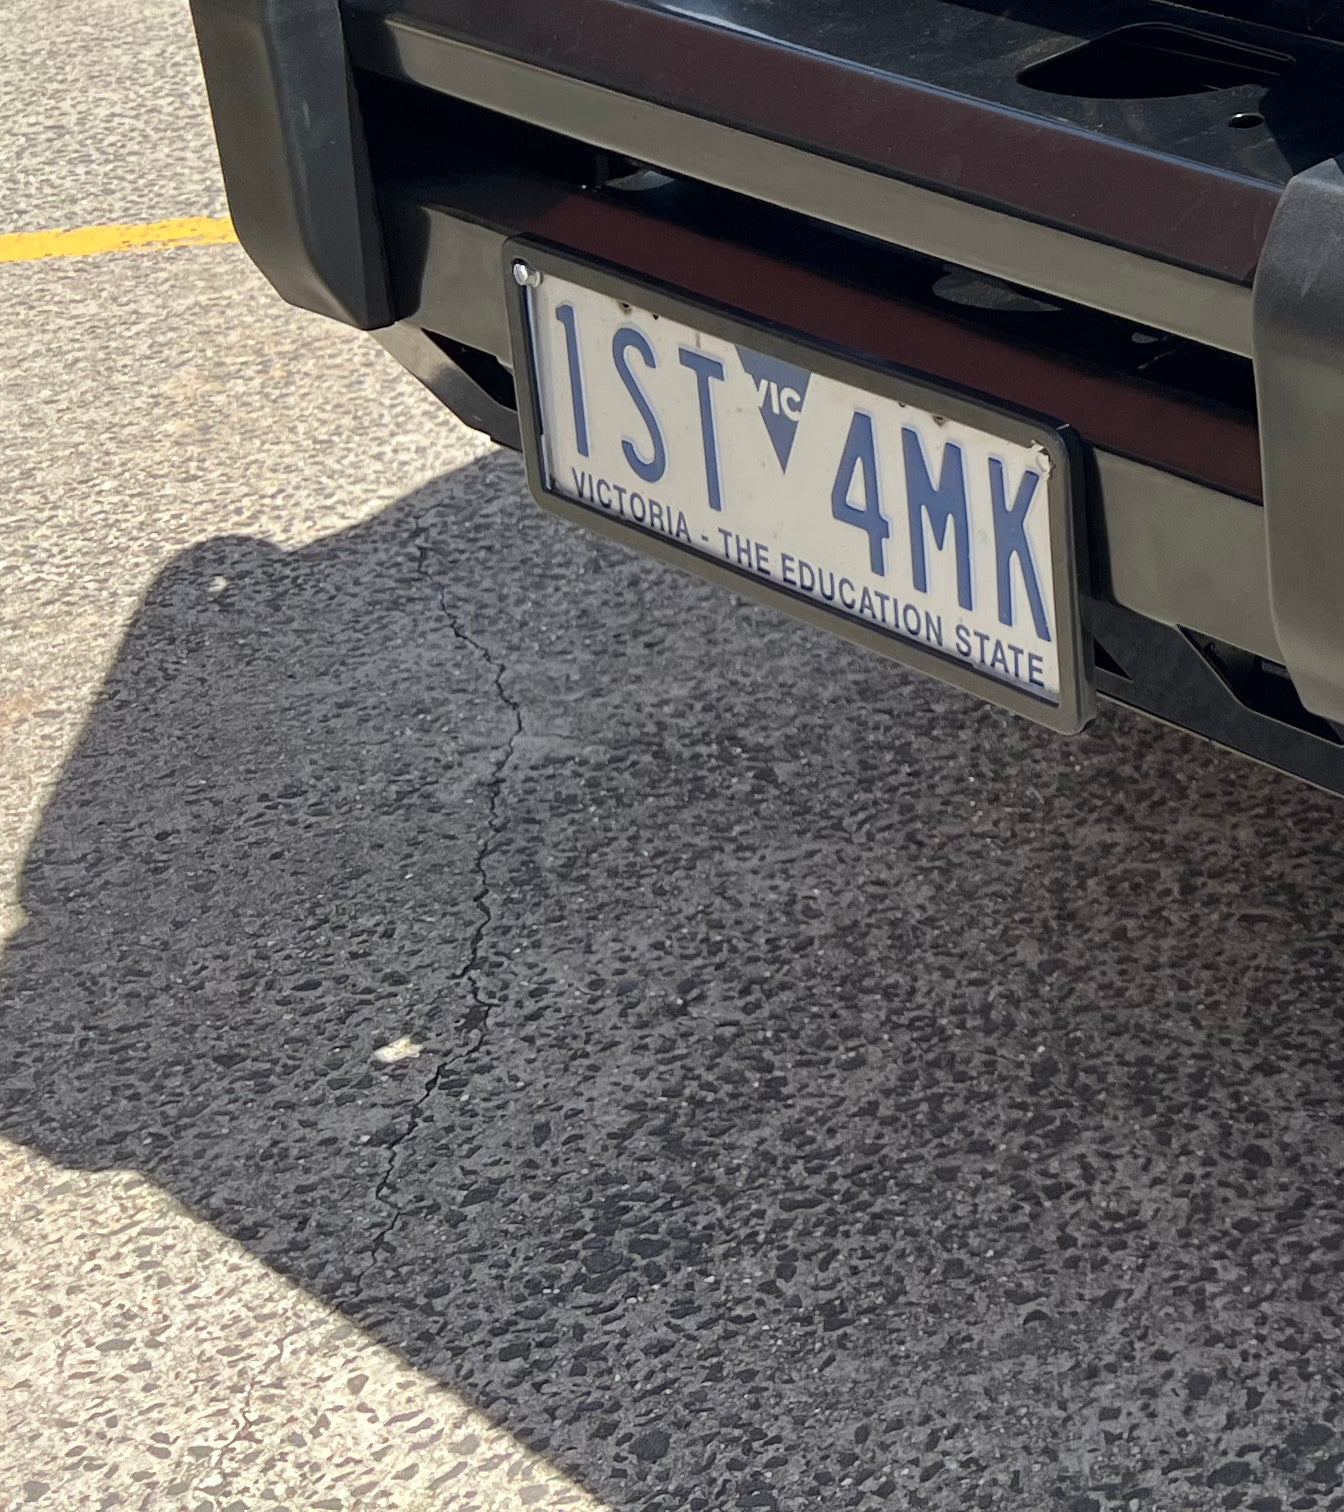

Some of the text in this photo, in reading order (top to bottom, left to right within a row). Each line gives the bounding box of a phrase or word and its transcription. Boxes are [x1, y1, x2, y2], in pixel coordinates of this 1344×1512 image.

[555, 303, 1051, 641] 1ST 4MK
[746, 372, 802, 422] VIC
[571, 466, 692, 543] VICTORIA
[718, 527, 771, 576] THE
[780, 552, 943, 647] EDUCATION
[955, 623, 1045, 688] STATE
